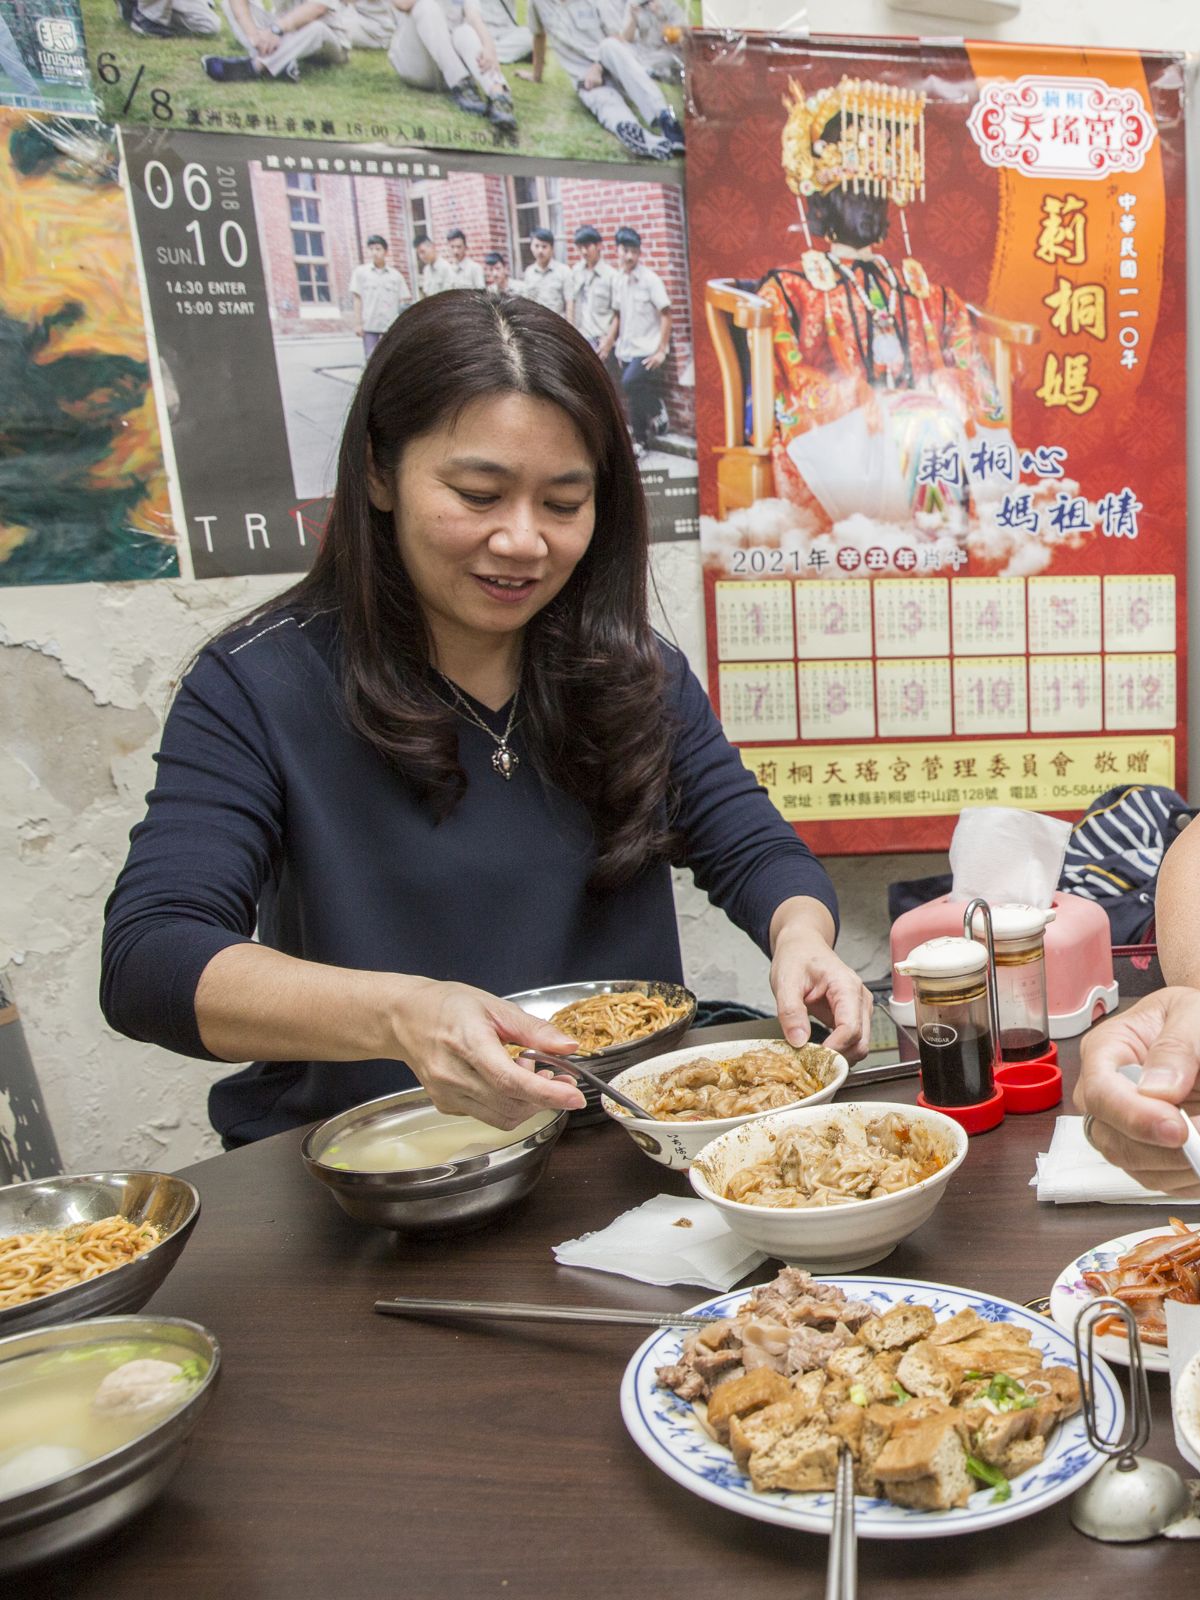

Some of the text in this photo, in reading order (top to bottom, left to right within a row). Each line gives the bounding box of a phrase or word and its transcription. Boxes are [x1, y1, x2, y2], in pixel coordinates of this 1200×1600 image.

[143, 160, 213, 212] 06
[216, 166, 240, 211] 2018
[185, 219, 248, 268] 10
[166, 280, 246, 296] 14:30 ENTER
[176, 301, 255, 316] 15:00 START
[996, 486, 1140, 535] 媽祖情
[1094, 749, 1150, 774] 敬贈
